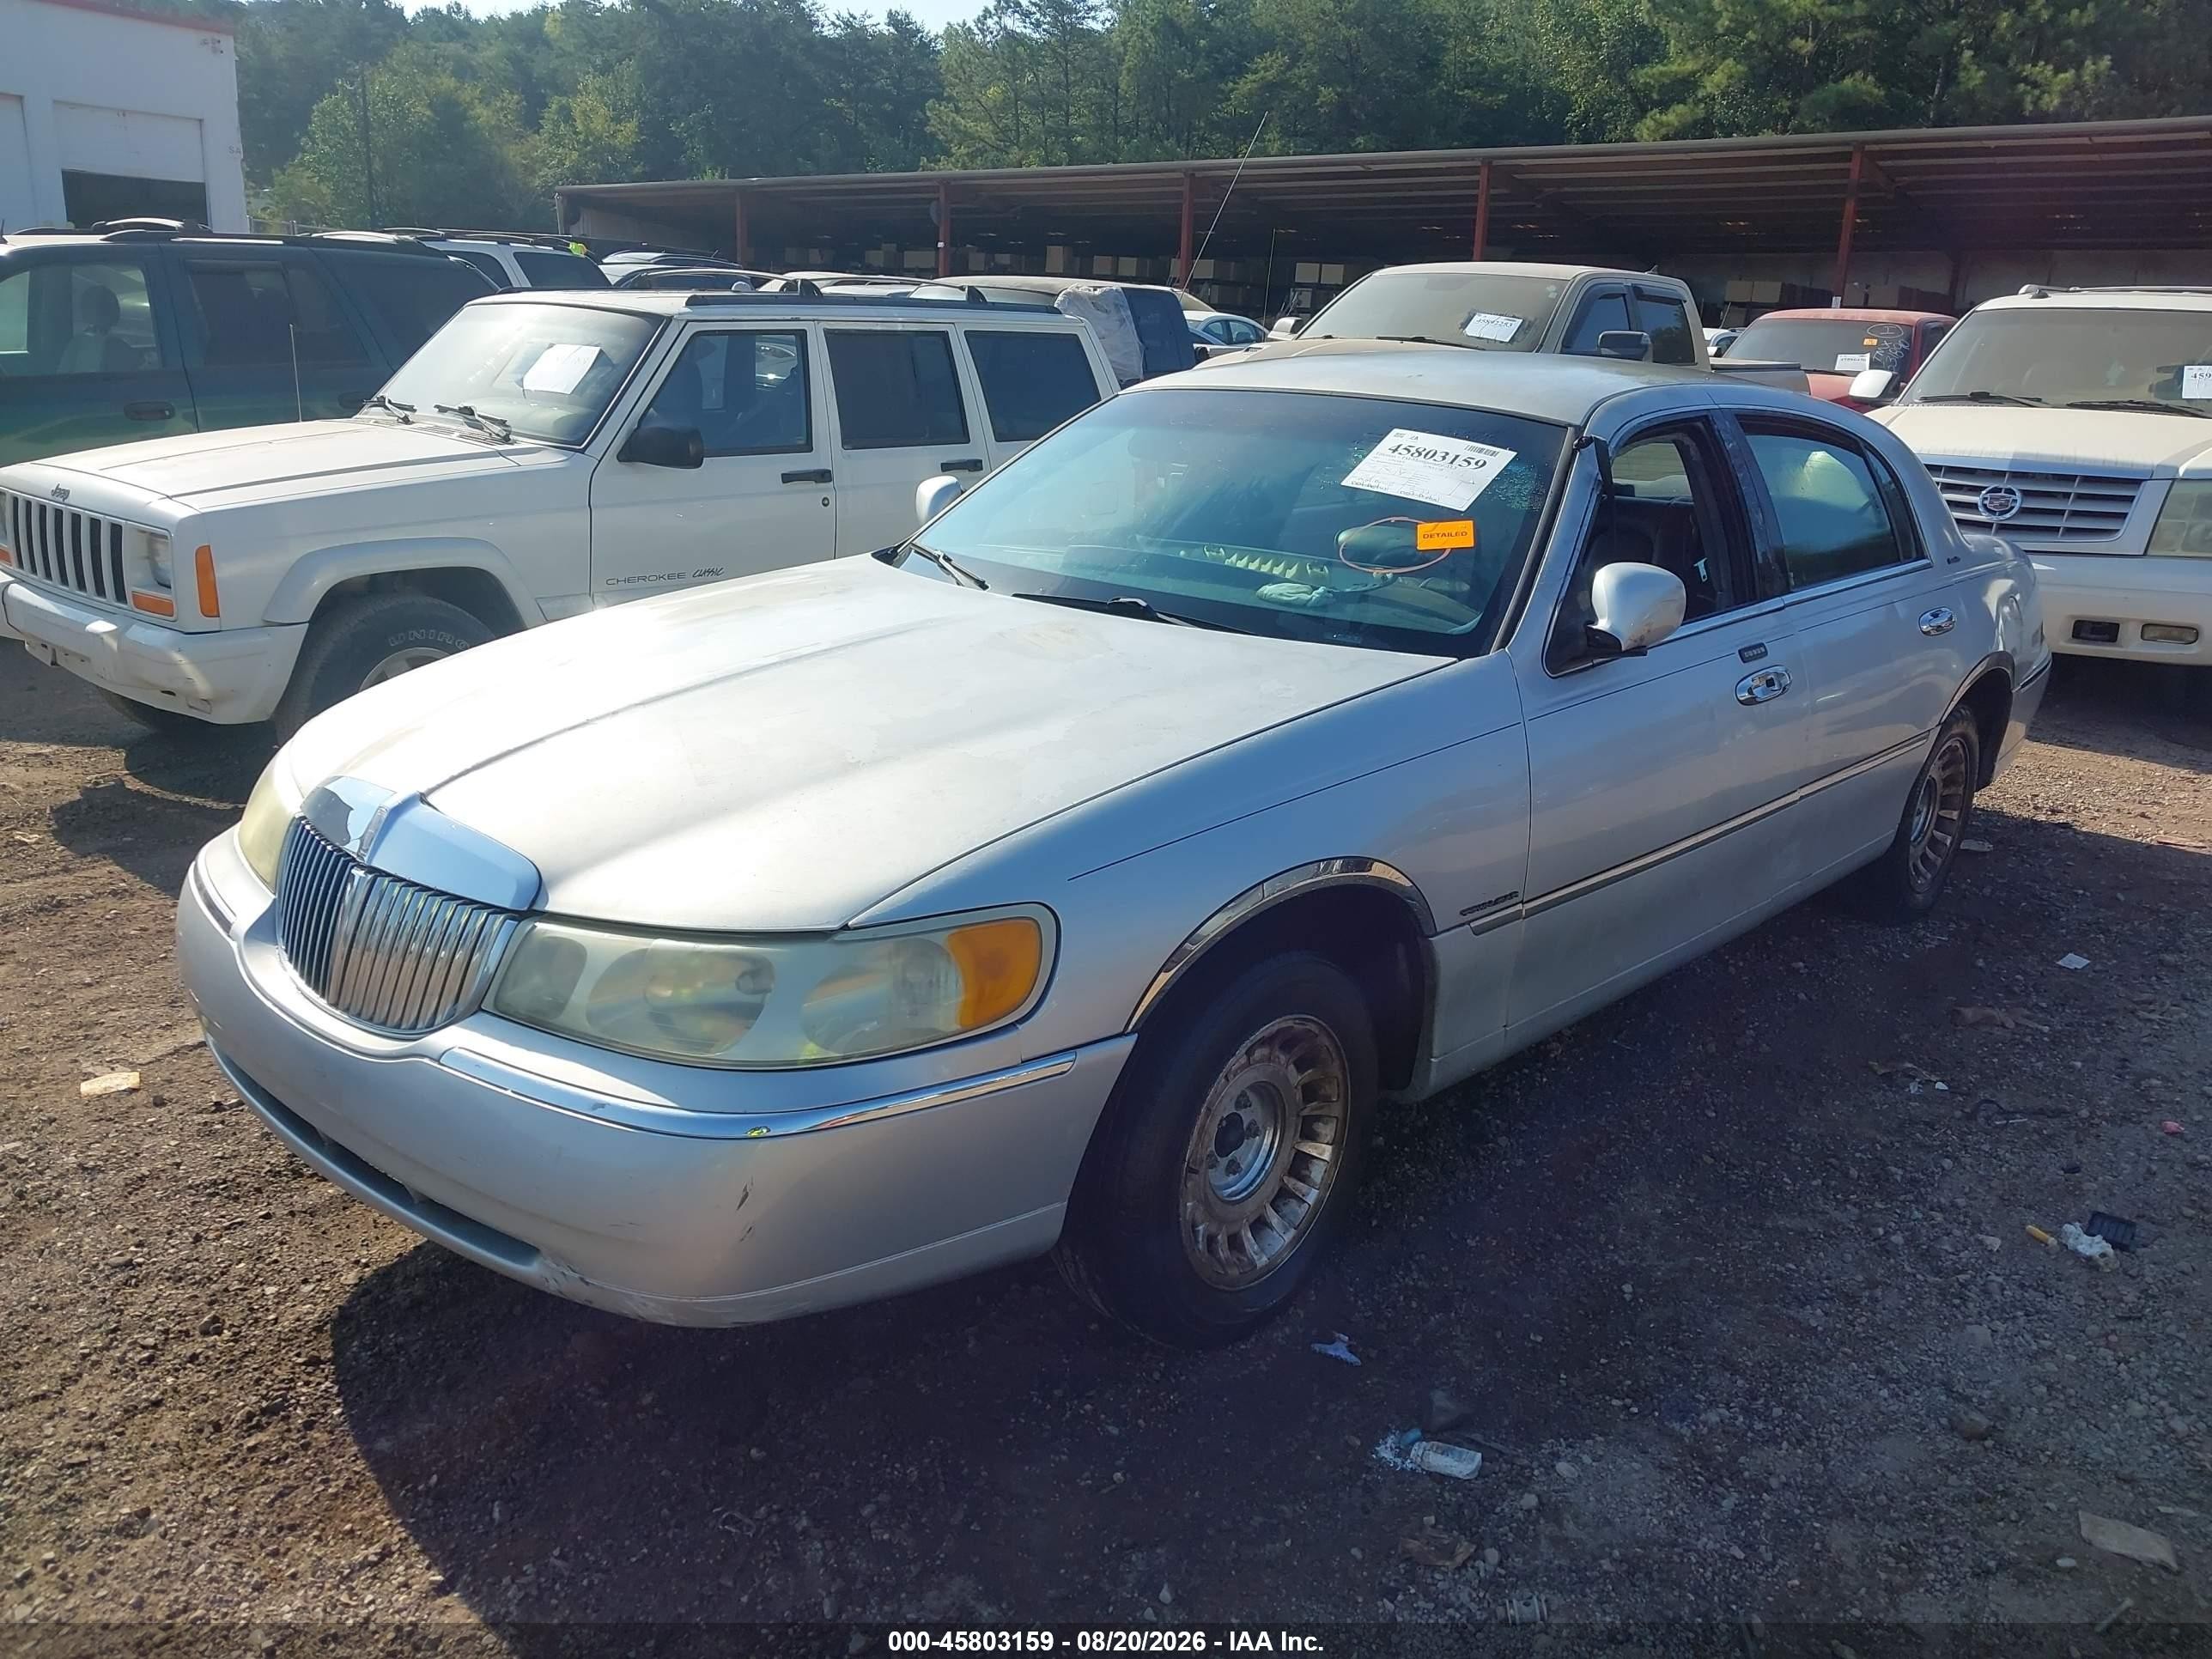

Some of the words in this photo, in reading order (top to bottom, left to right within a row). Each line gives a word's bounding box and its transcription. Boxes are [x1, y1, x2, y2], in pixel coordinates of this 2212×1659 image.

[1388, 442, 1487, 470] 45803159
[52, 483, 70, 501] Jeep
[1422, 531, 1468, 539] DETAILED
[606, 572, 687, 586] CHEROKEE
[692, 567, 724, 578] CLASSIC
